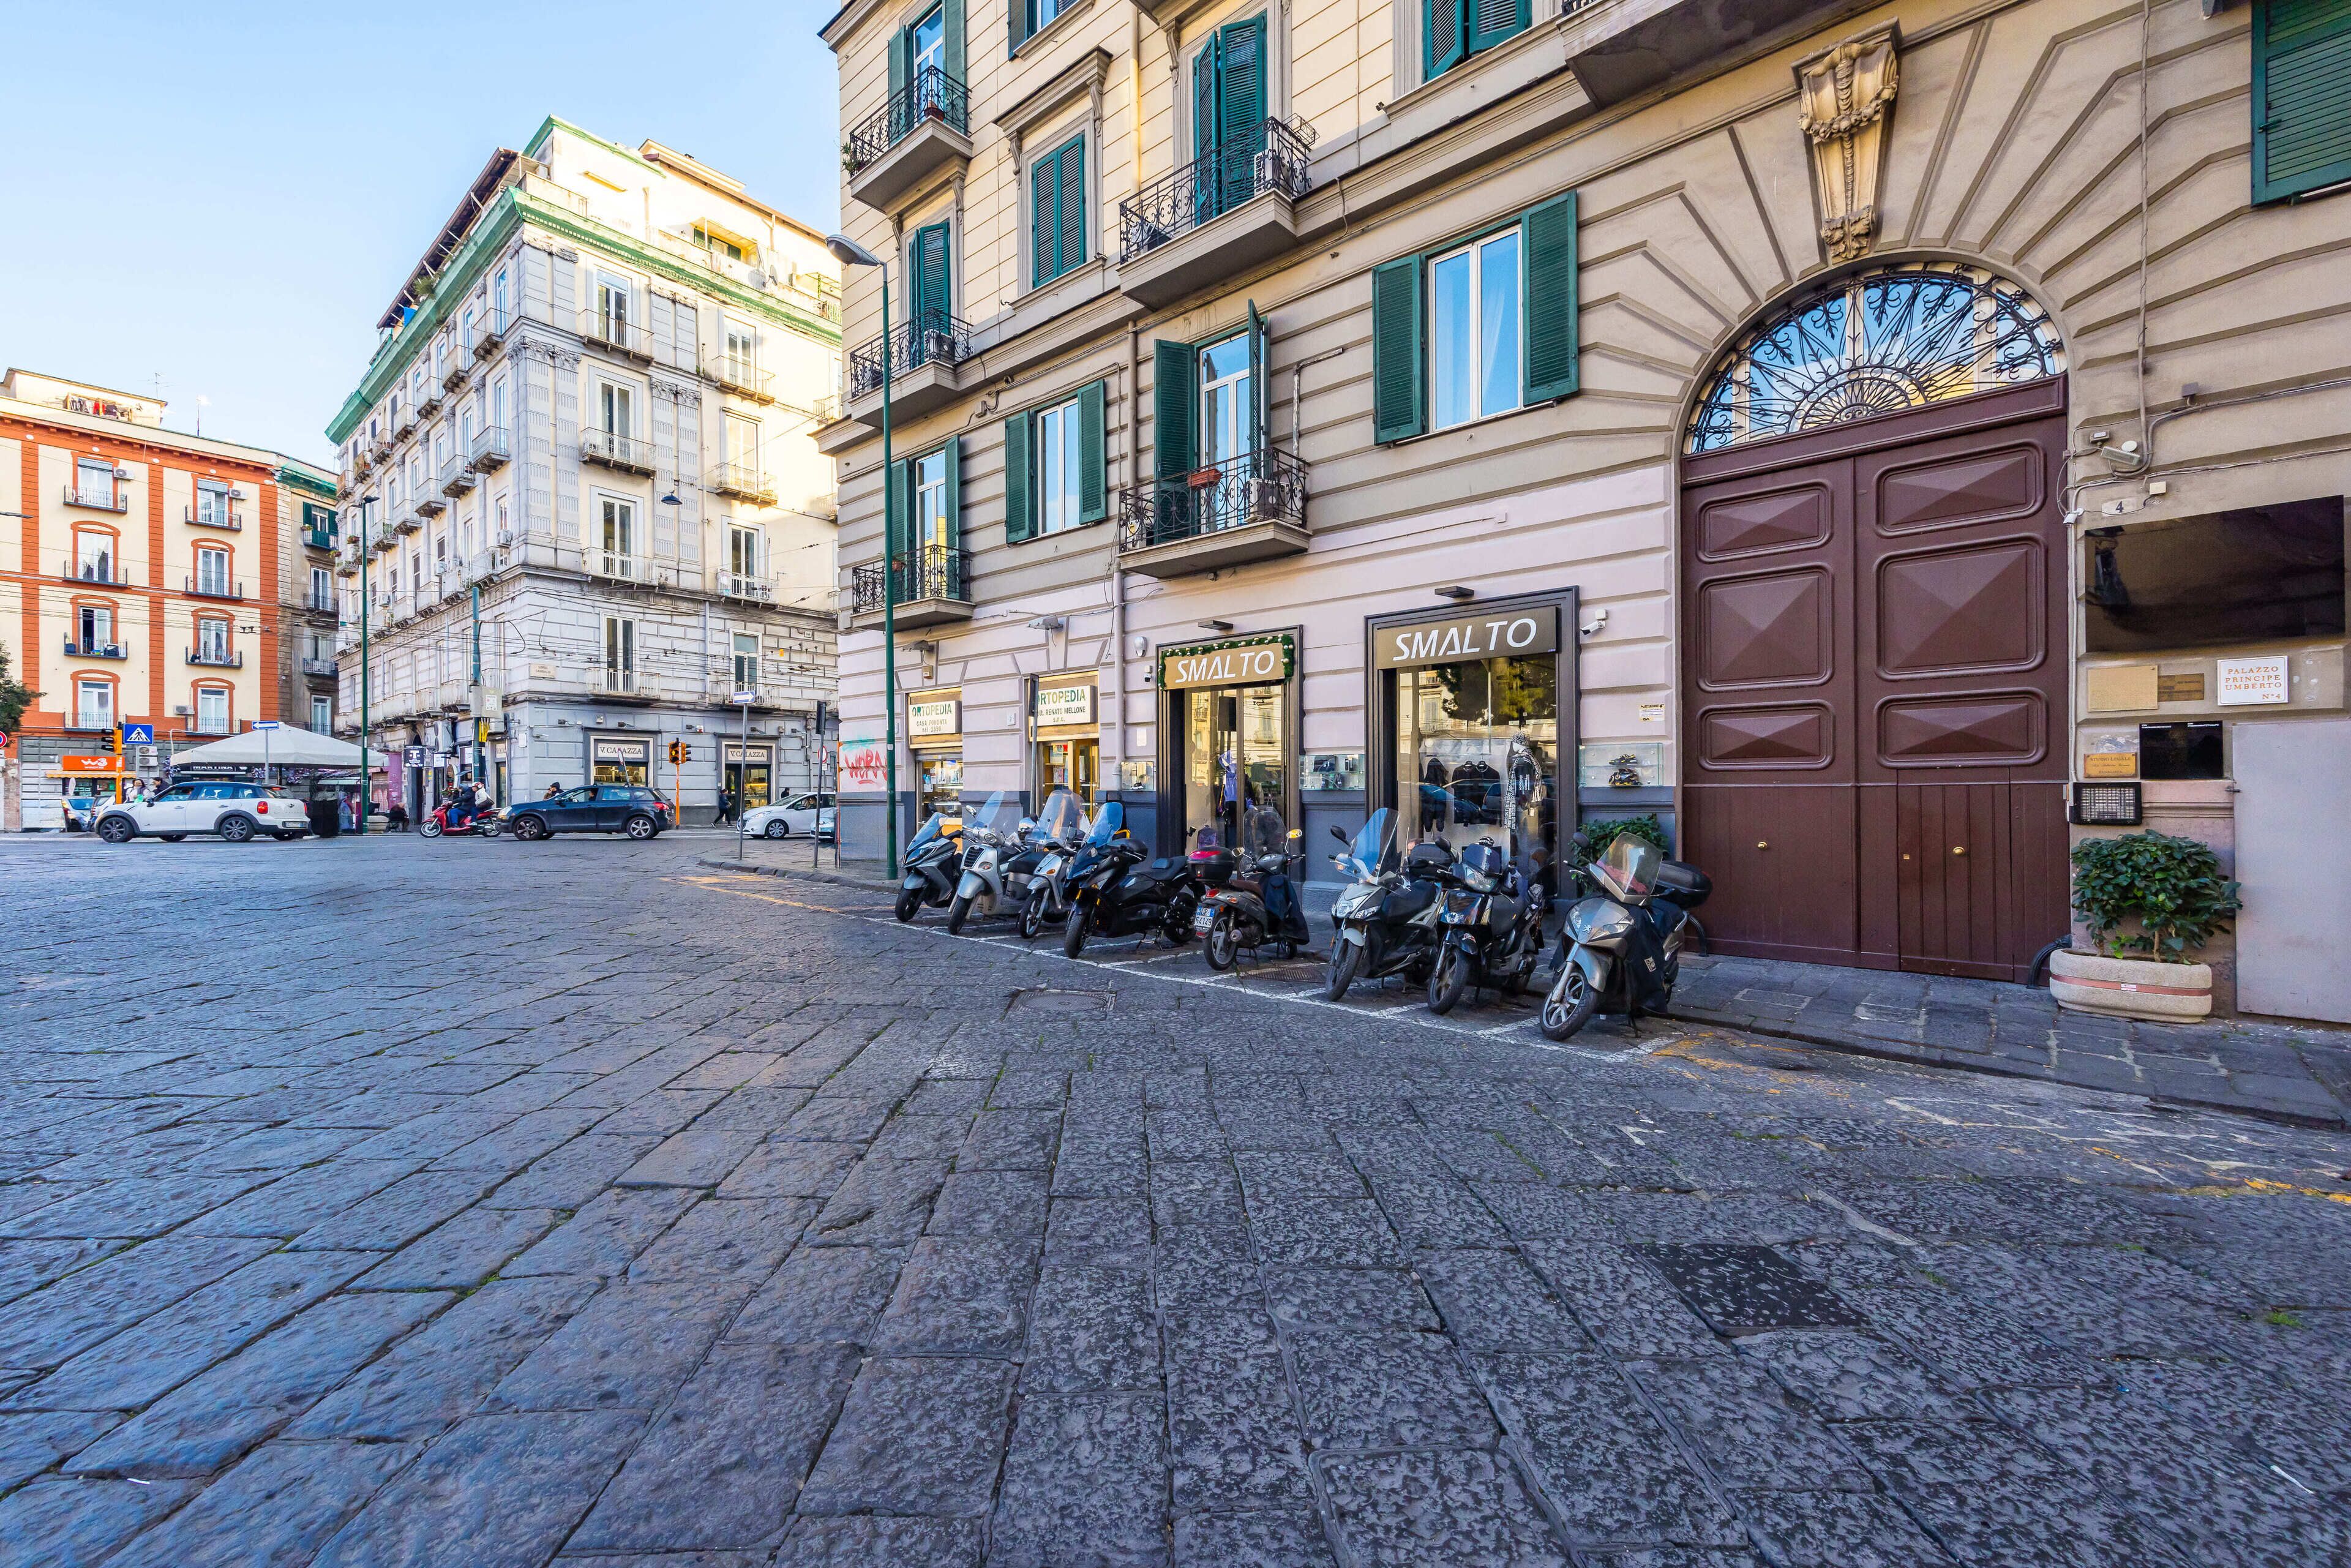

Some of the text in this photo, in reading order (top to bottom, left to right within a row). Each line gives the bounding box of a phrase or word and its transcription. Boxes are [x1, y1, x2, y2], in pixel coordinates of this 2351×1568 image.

[2115, 501, 2124, 513] 4
[1393, 618, 1537, 661] SMALTO
[1175, 650, 1275, 683] SMALTO
[2225, 675, 2281, 683] PRINCIPE
[2225, 682, 2282, 691] UMBERTO
[912, 703, 952, 717] ORTOPEDIA
[1045, 708, 1063, 716] RENATO
[1064, 706, 1086, 715] MELLONE
[1195, 917, 1212, 926] 64149
